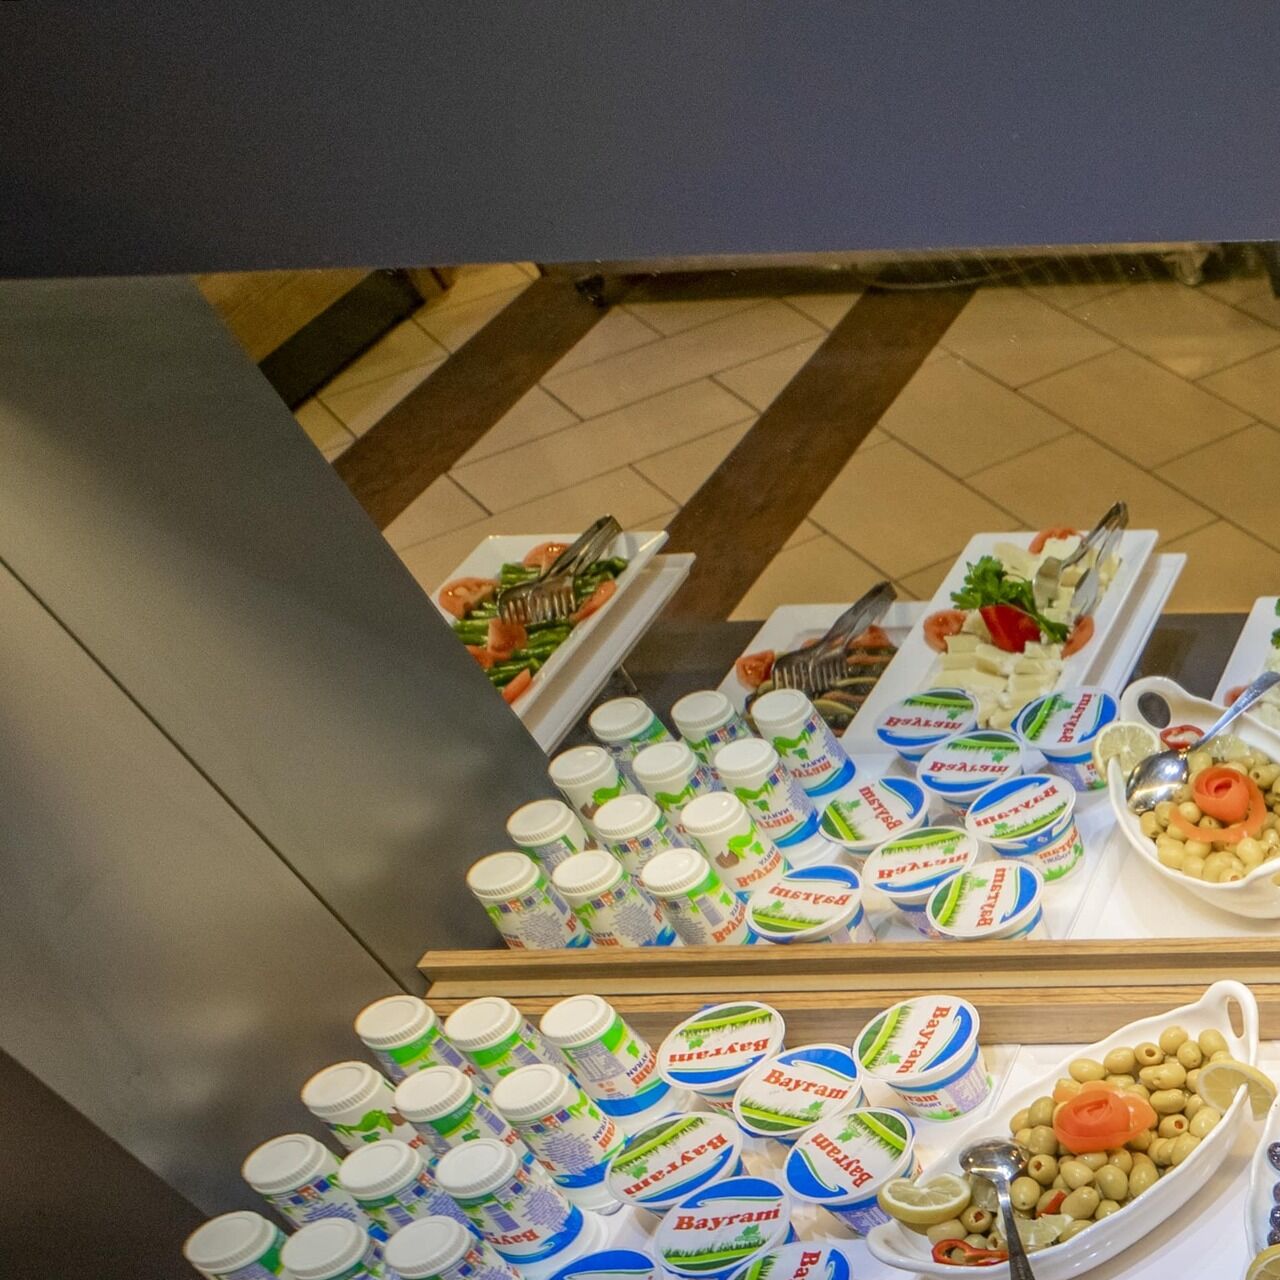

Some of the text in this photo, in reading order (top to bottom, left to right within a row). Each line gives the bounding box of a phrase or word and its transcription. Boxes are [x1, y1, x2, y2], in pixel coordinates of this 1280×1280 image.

[669, 1038, 770, 1064] Bayram
[896, 1006, 951, 1074] Bayram
[763, 1069, 851, 1100] Bayram
[623, 1133, 729, 1197] Bayram
[810, 1132, 874, 1188] Bayram
[673, 1206, 781, 1232] Bayram
